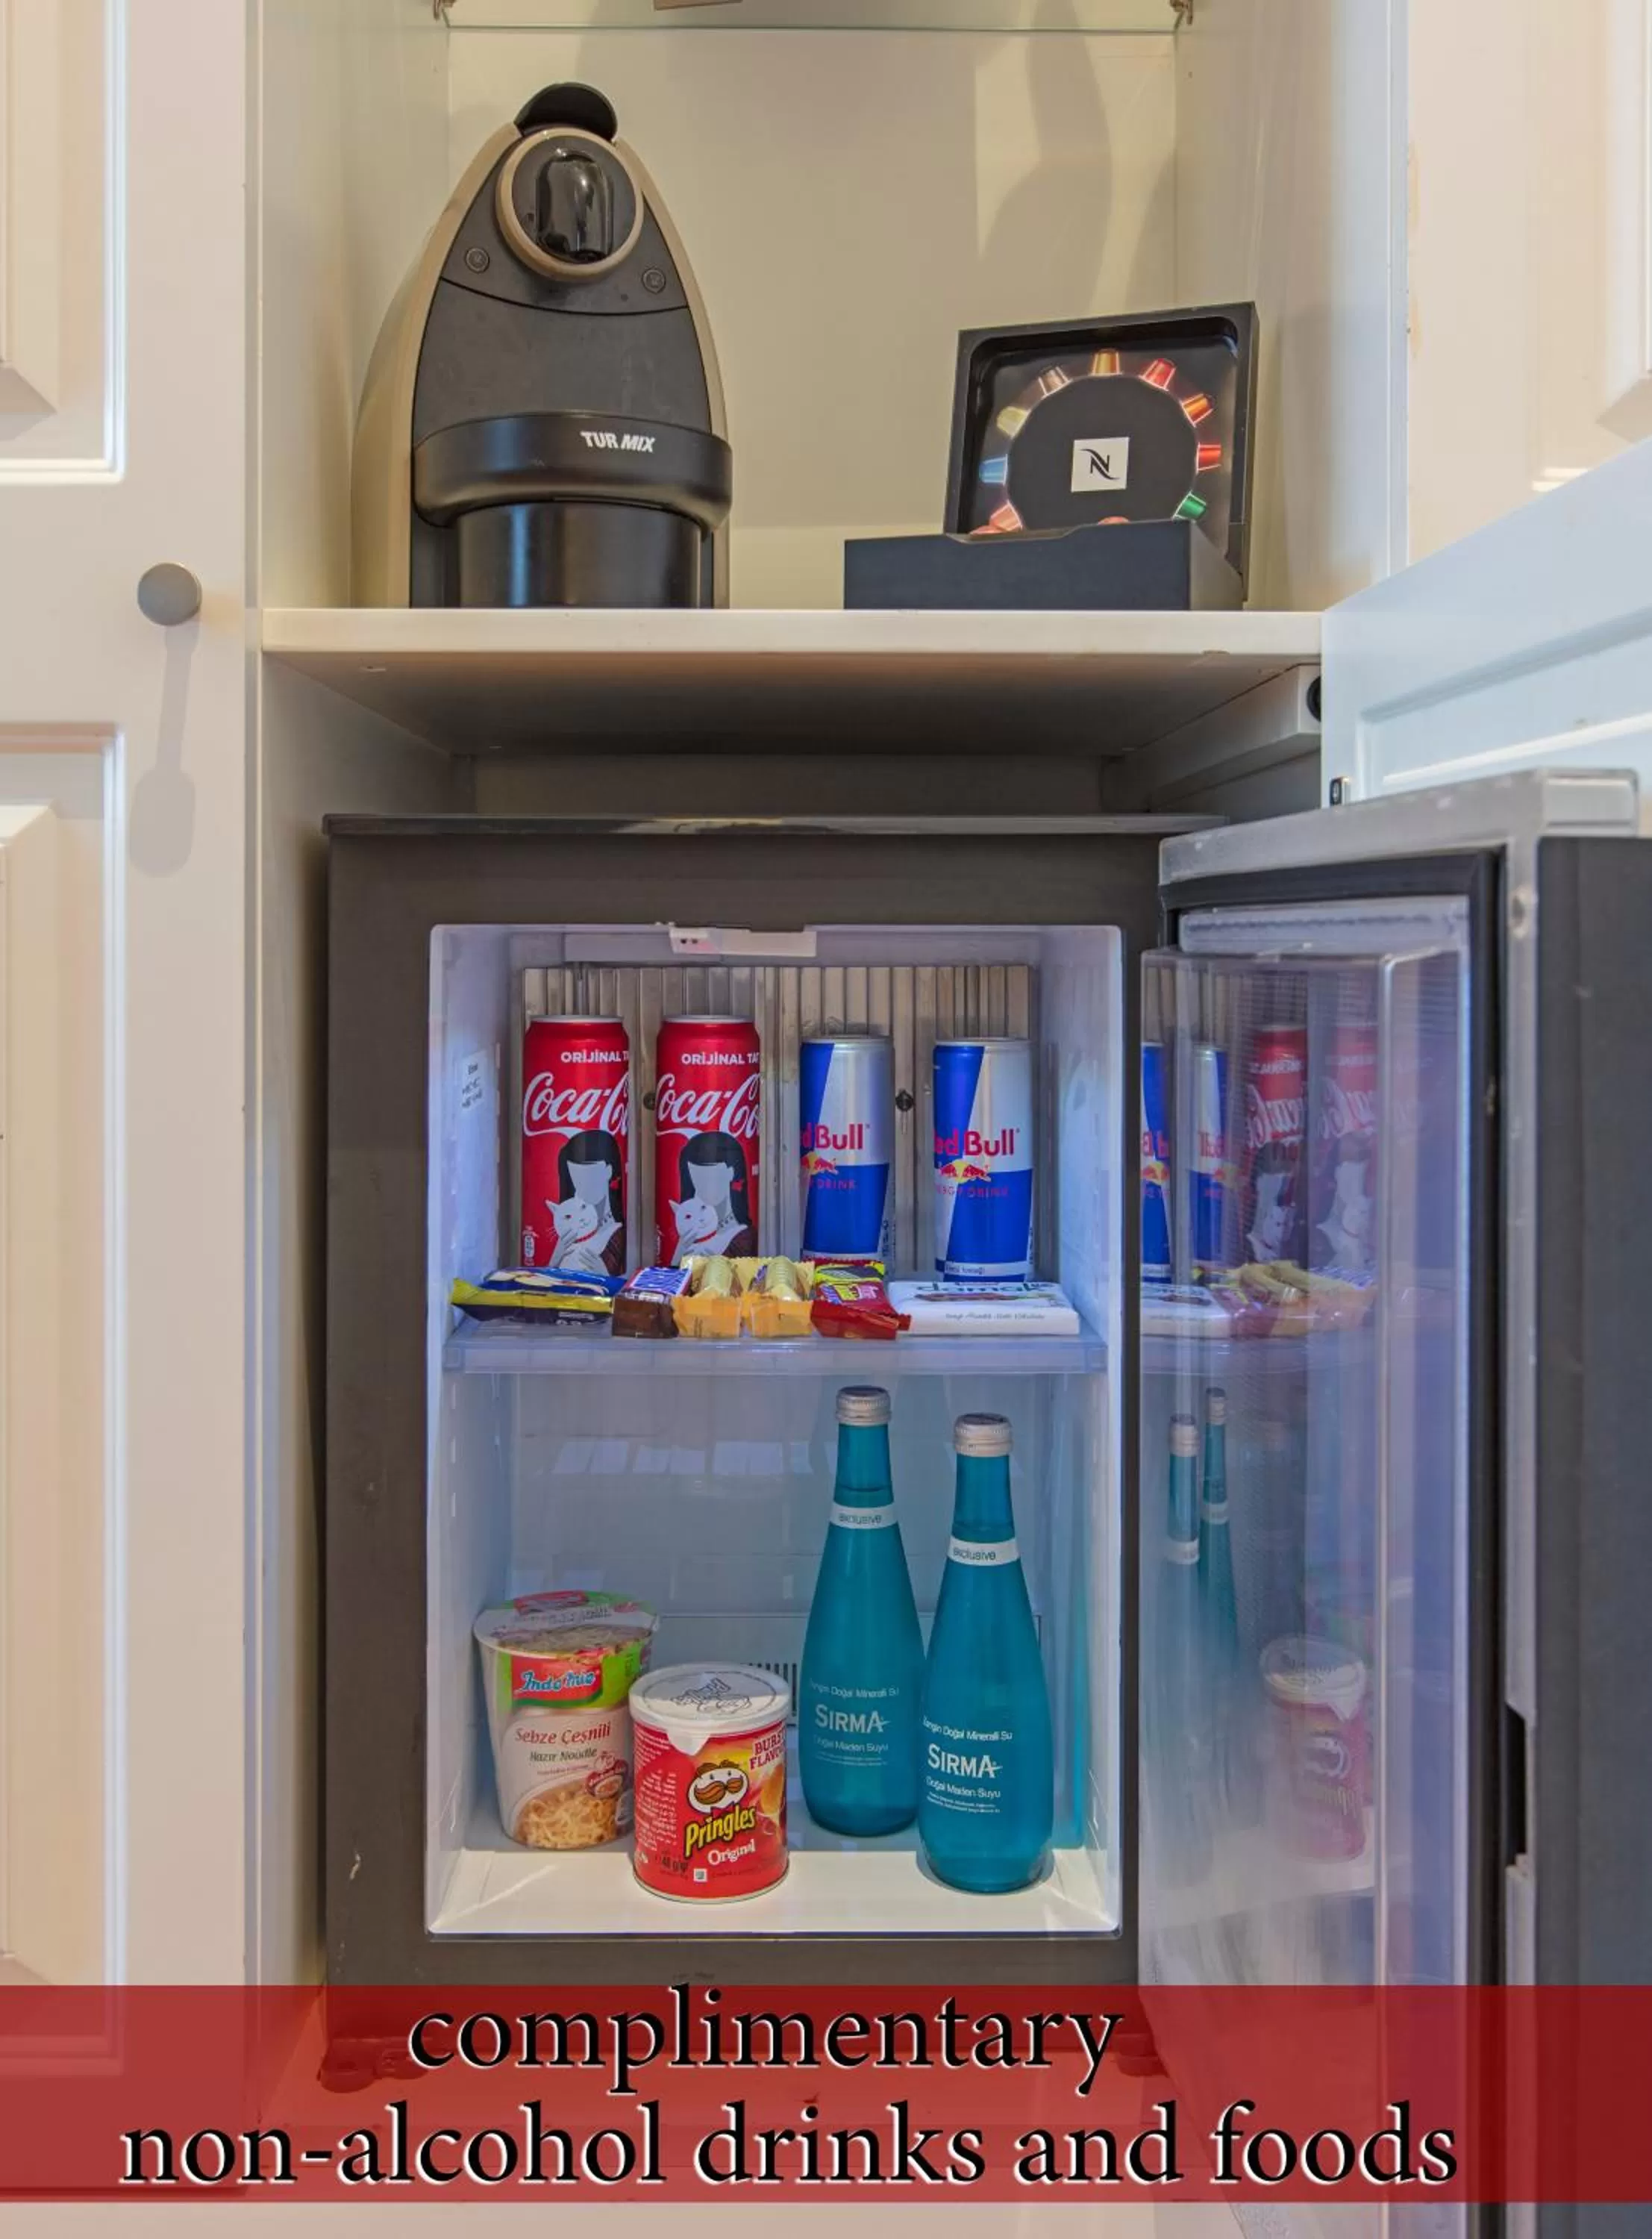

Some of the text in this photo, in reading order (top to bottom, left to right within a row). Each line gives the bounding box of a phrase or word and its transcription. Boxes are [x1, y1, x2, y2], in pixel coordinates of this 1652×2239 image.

[815, 1122, 863, 1151] Bull
[964, 1128, 1014, 1157] Bull
[952, 1546, 997, 1561] exclusive
[814, 1703, 888, 1734] SIRMA
[927, 1743, 1001, 1779] SIRMA
[684, 1803, 756, 1858] Pringles
[707, 1838, 756, 1866] Original
